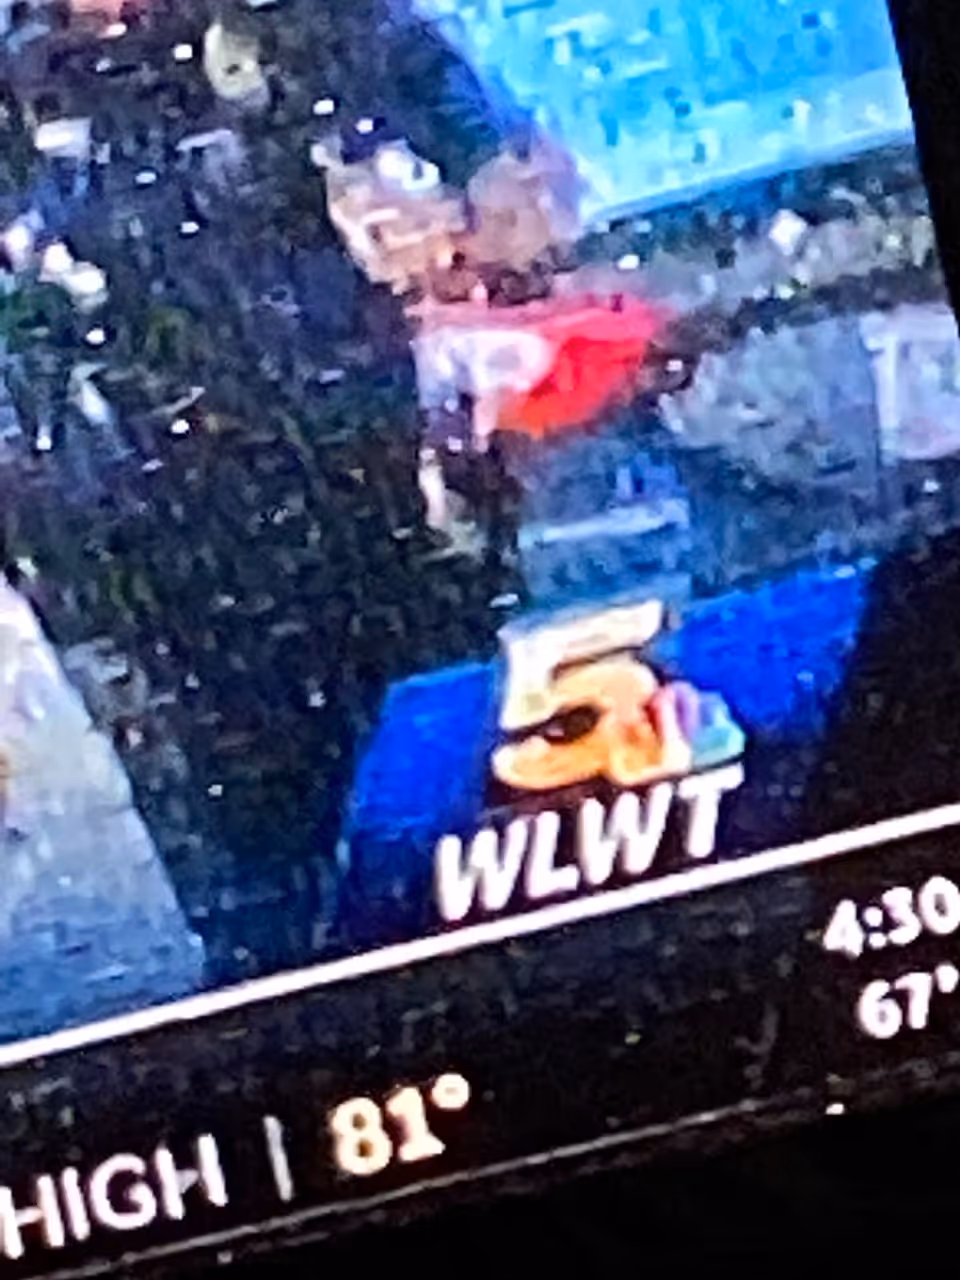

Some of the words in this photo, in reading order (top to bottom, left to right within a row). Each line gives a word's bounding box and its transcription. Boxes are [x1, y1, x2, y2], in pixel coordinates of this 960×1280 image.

[492, 598, 662, 790] 5
[434, 763, 745, 921] WLWT
[0, 1133, 229, 1260] HIGH
